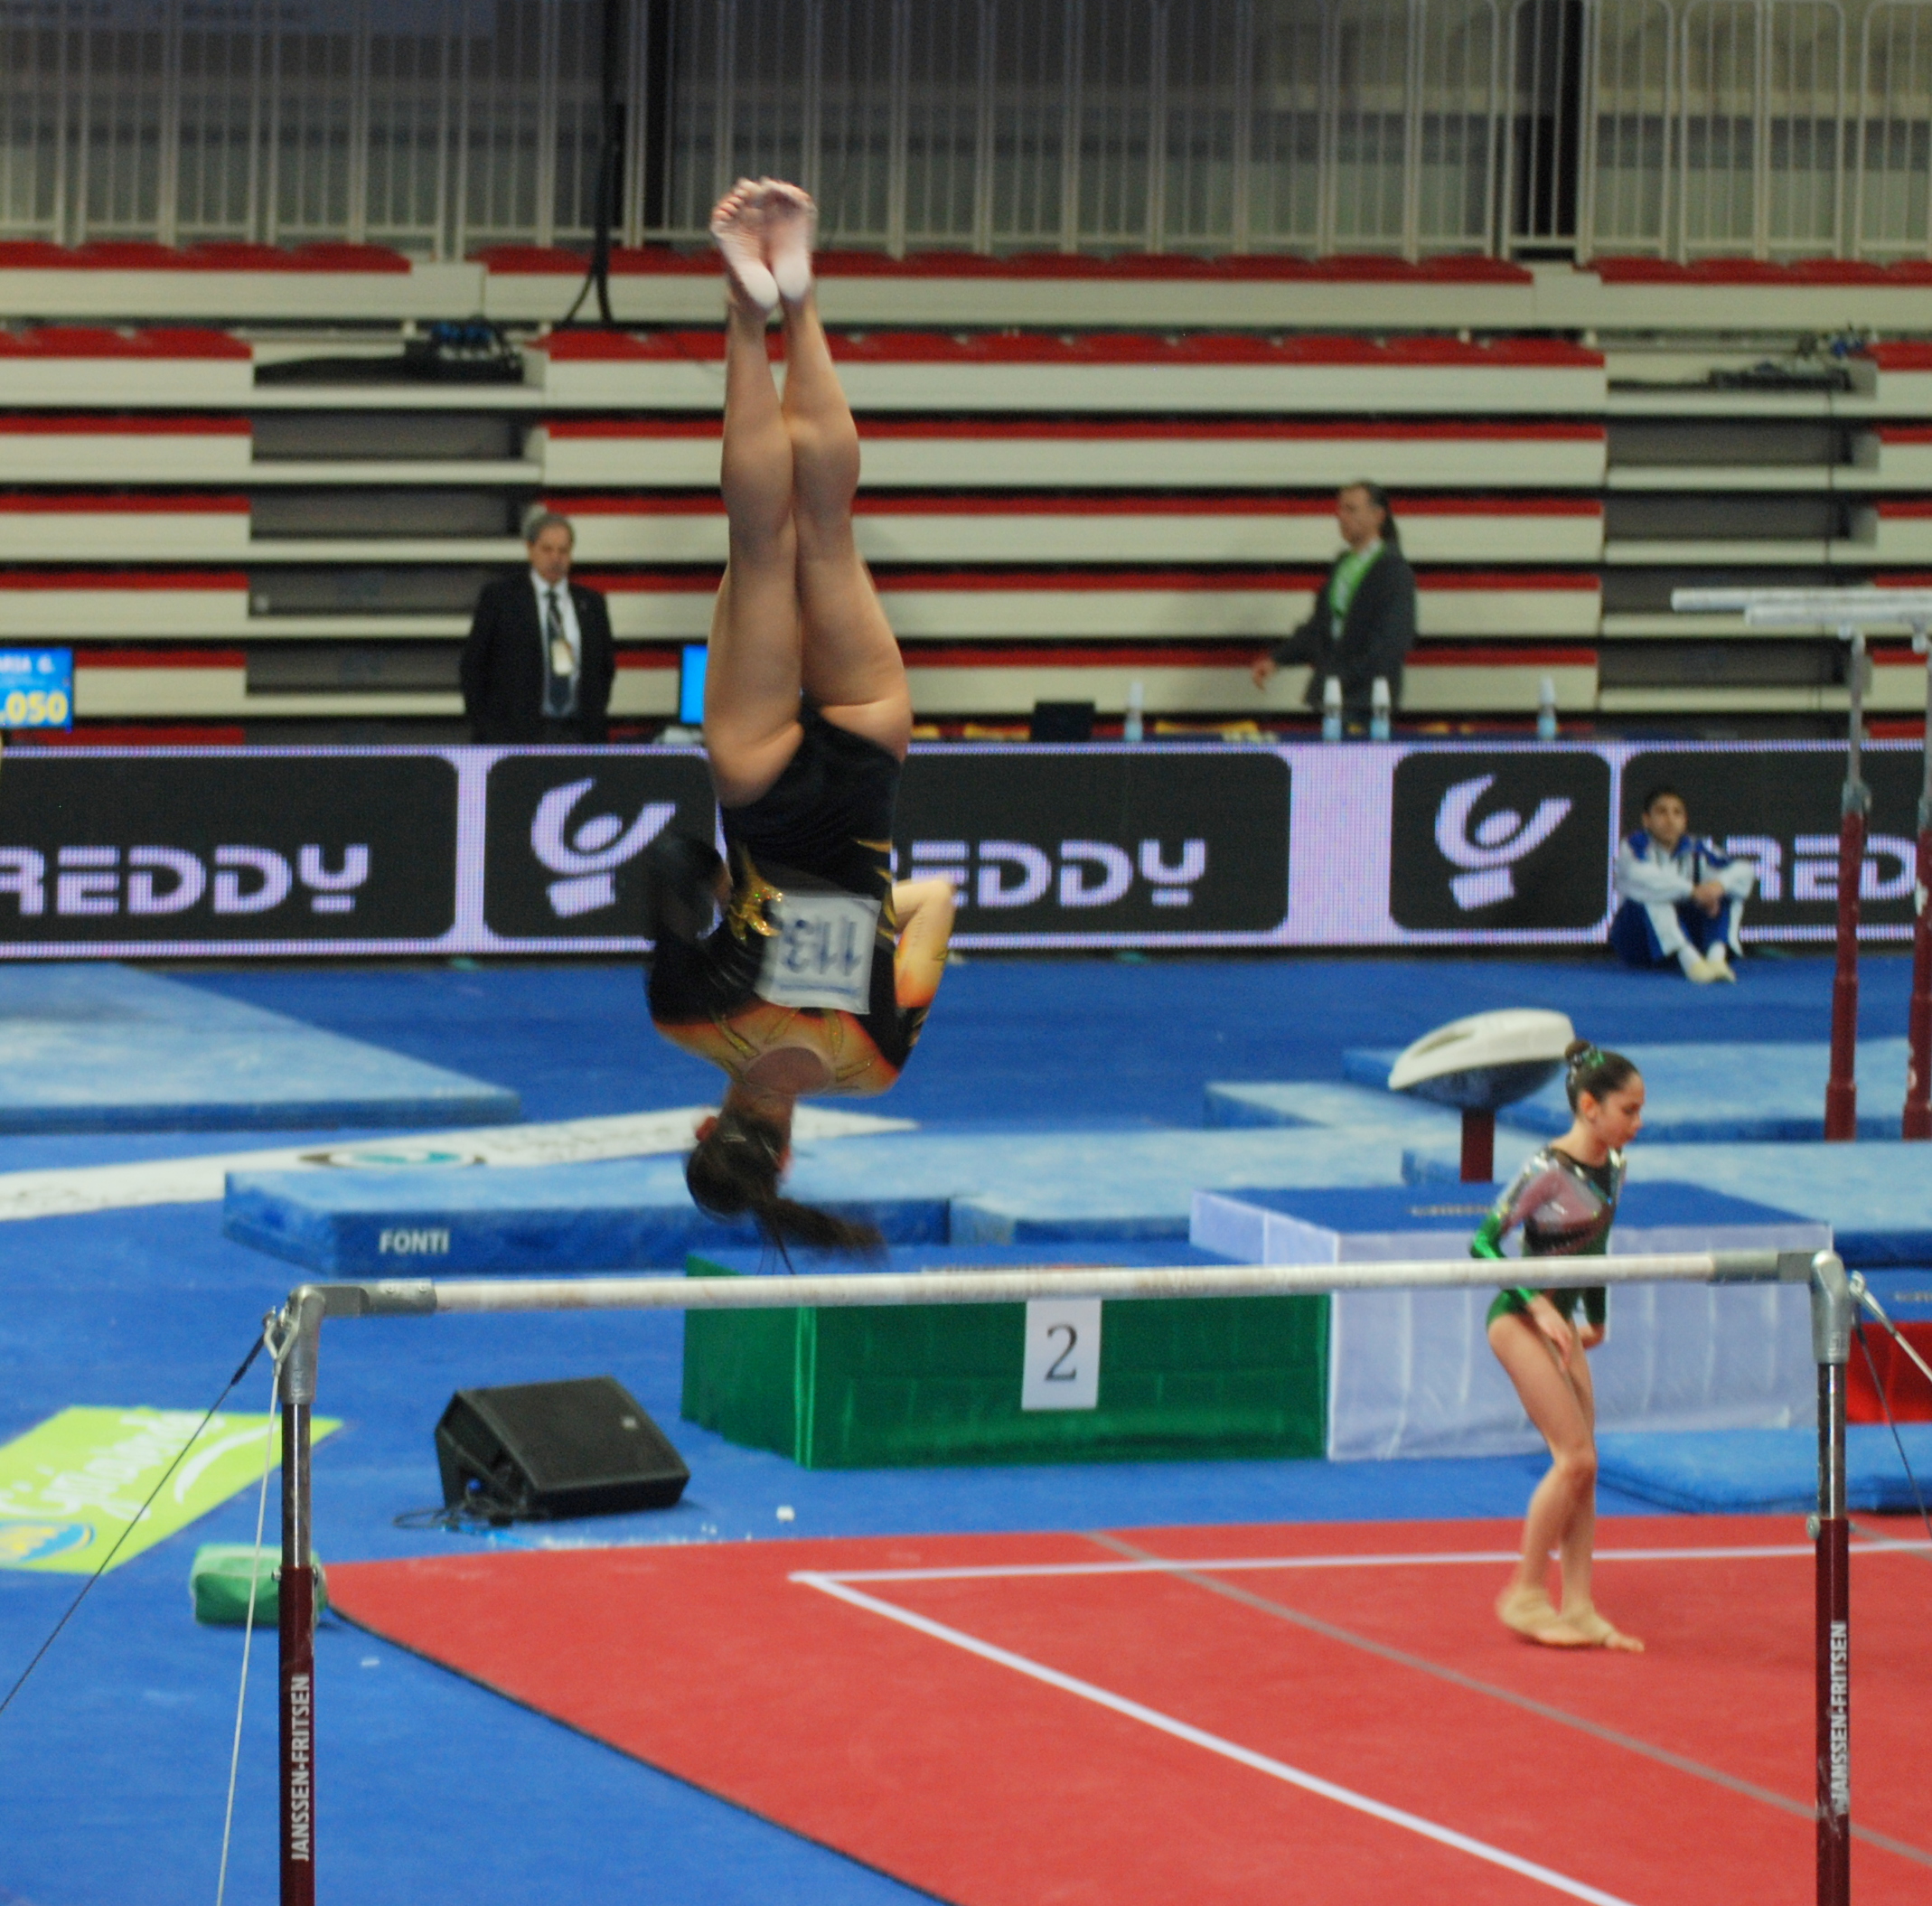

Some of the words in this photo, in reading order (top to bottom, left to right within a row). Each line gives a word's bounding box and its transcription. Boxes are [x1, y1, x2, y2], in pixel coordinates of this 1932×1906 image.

[891, 838, 1205, 906] EDDY
[783, 918, 861, 975] 113
[380, 1229, 449, 1253] FONTI
[1045, 1323, 1077, 1381] 2
[291, 1674, 310, 1862] JANSSEN-FRITSEN
